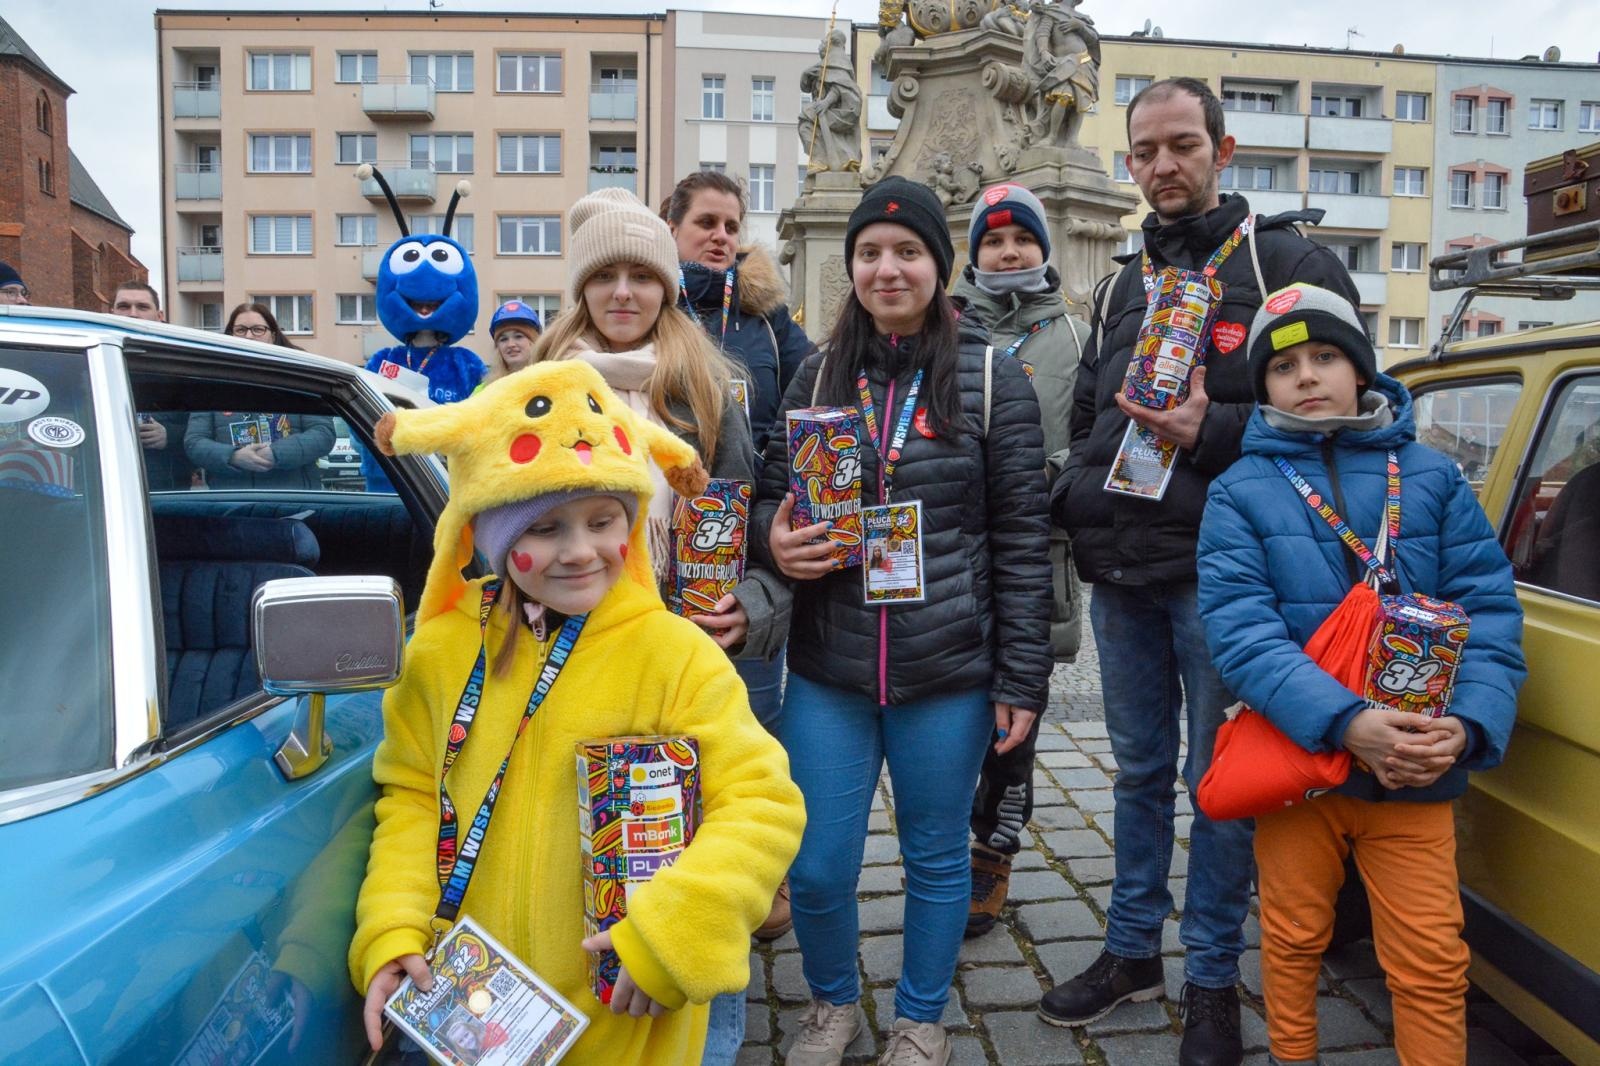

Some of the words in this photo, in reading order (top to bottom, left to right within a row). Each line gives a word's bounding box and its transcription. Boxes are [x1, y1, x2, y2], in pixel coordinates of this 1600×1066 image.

[1159, 359, 1187, 376] allegro
[892, 397, 916, 449] WSPIERAM
[820, 500, 852, 520] WSZYSTKO
[692, 513, 738, 551] 32
[1395, 651, 1420, 663] 2024
[1378, 660, 1443, 695] 32
[649, 766, 672, 779] onet
[633, 825, 678, 842] mBank
[444, 858, 473, 905] RAM
[451, 944, 473, 977] 32
[414, 1008, 426, 1021] PO
[424, 979, 454, 1012] PANDEMII
